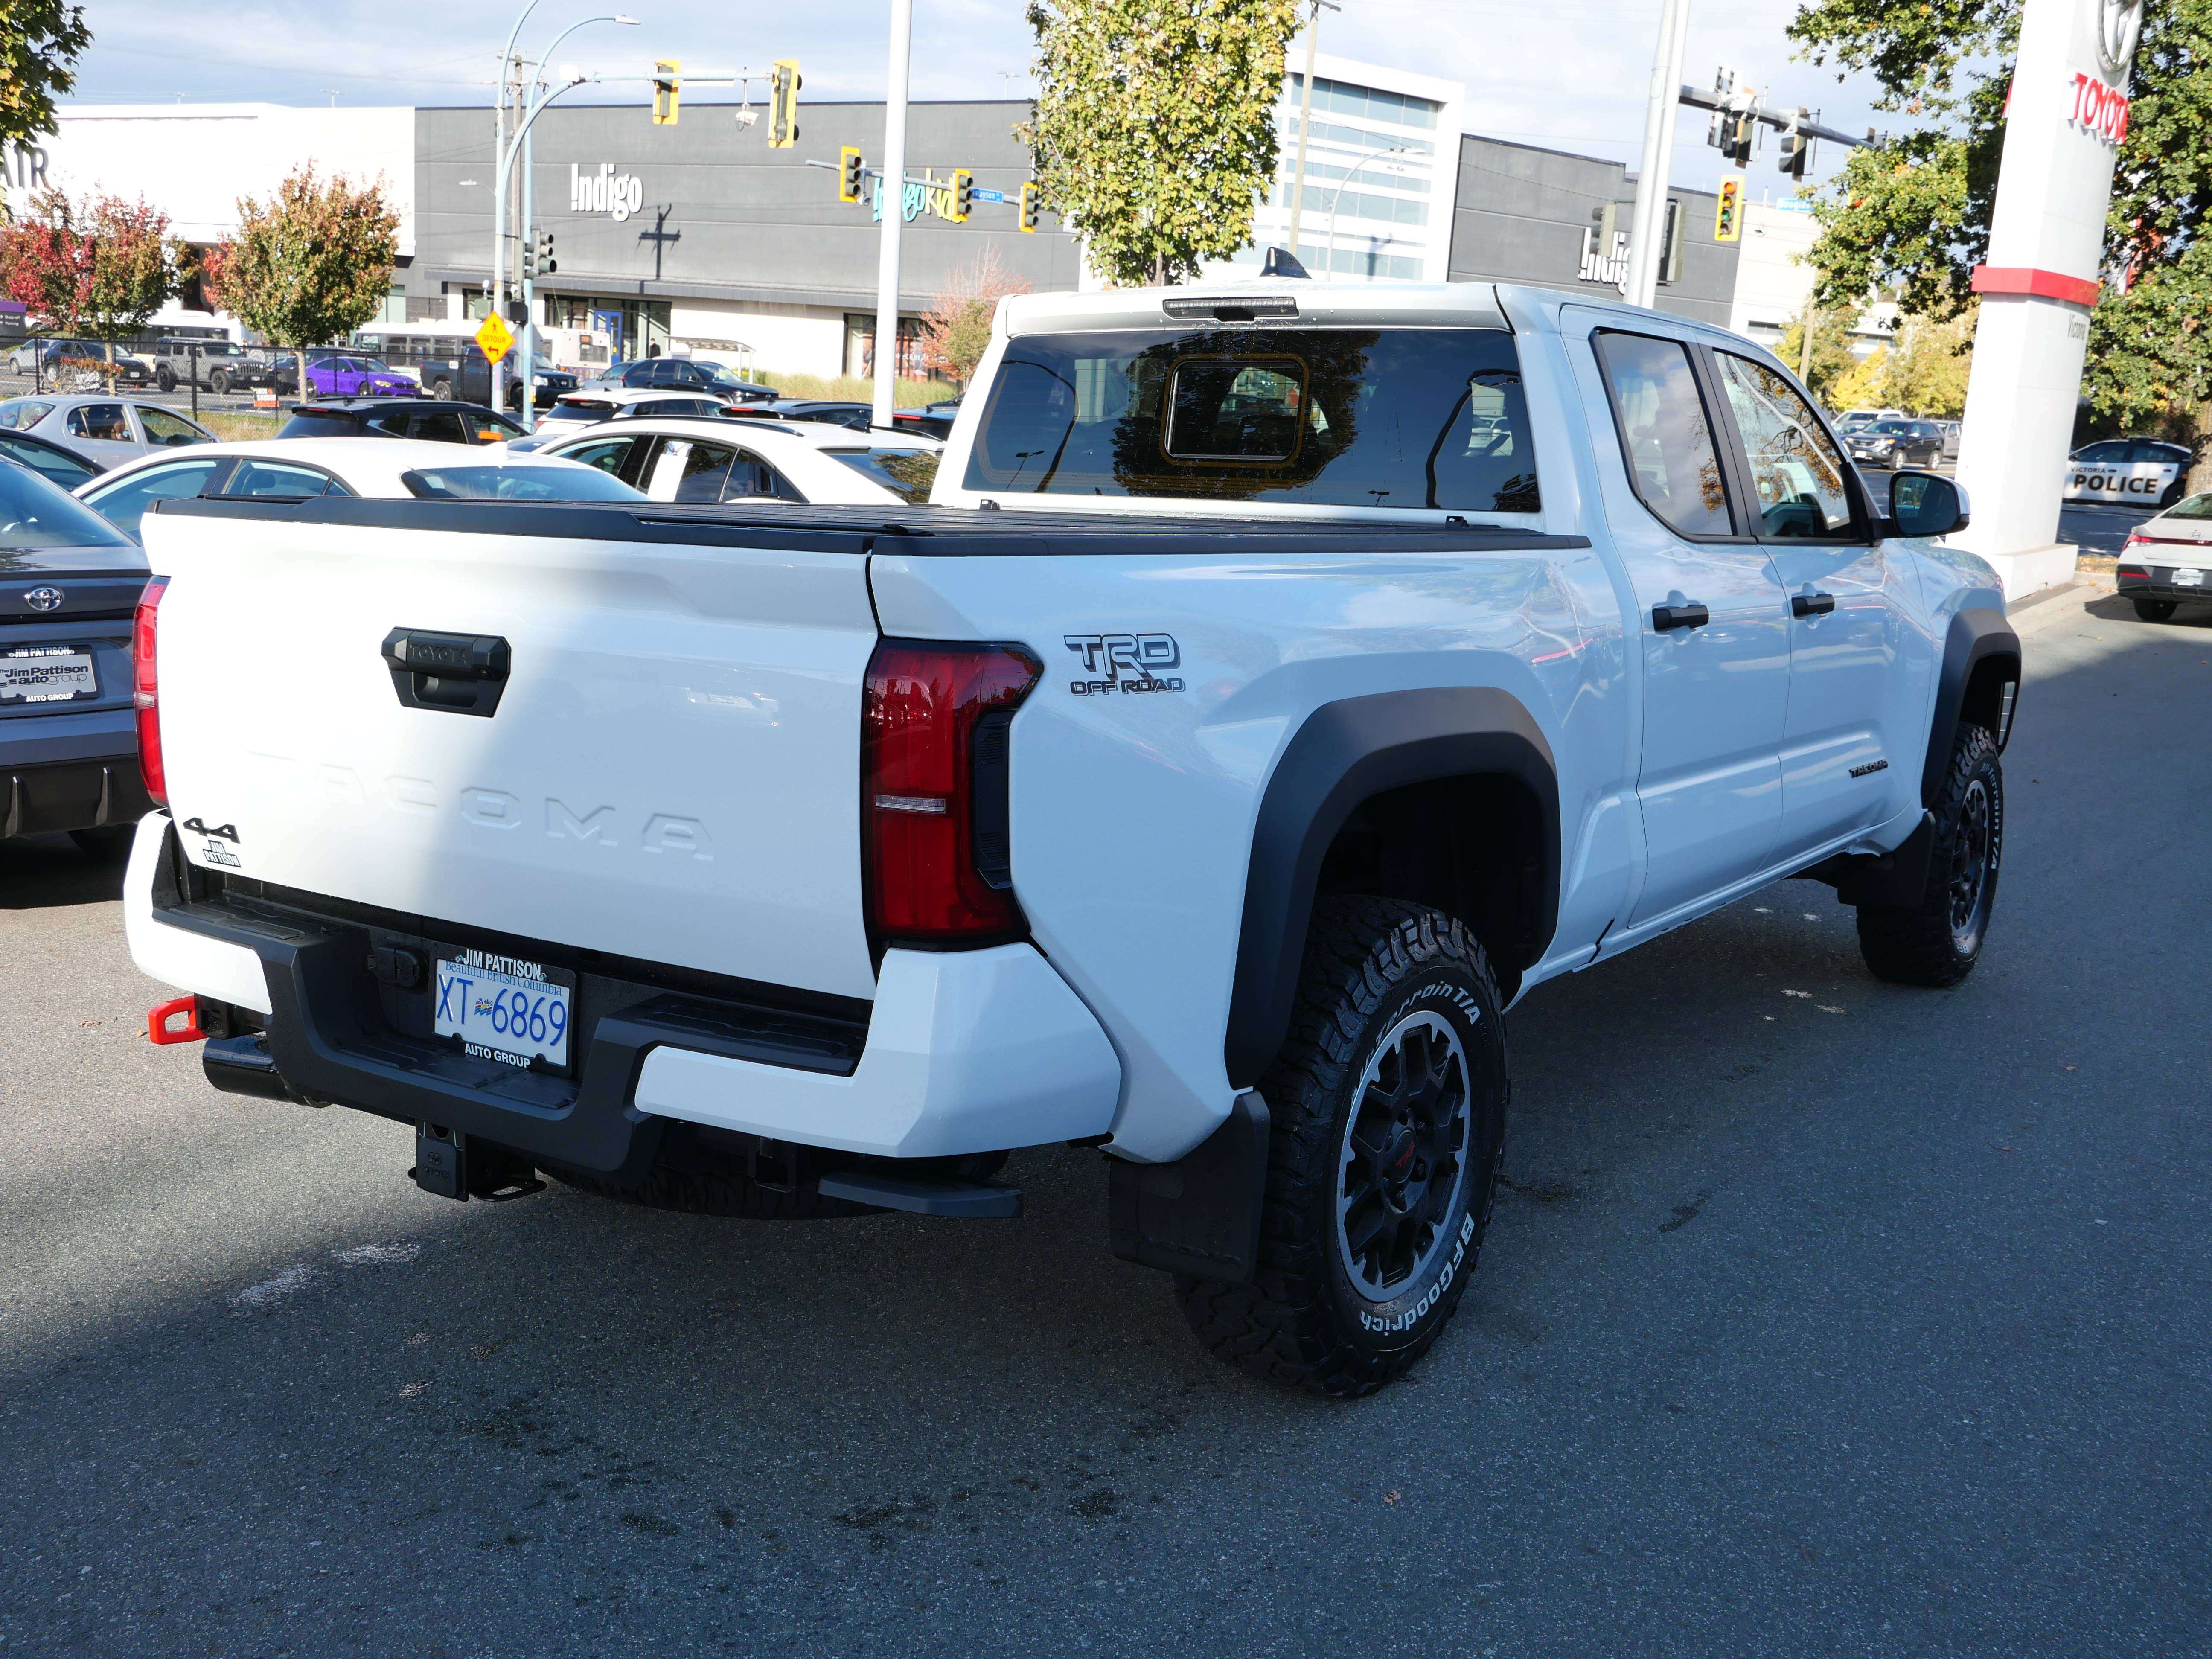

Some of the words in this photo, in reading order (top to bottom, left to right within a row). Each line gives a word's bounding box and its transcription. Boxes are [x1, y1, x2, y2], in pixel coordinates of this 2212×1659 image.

[482, 335, 506, 343] DETOUR
[2073, 474, 2158, 494] POLICE
[15, 648, 29, 658] JIM
[30, 646, 70, 657] PATTISON
[410, 643, 467, 664] TOYOTA
[1064, 633, 1179, 679] TRD
[5, 668, 29, 678] Jim
[31, 665, 89, 676] Pattison
[1070, 681, 1118, 696] OFF
[1121, 678, 1185, 695] ROAD
[47, 693, 74, 701] GROUP
[210, 841, 226, 853] JIM
[204, 850, 241, 867] PATTISON
[463, 949, 483, 968] JIM
[486, 953, 542, 981] PATTISON
[446, 961, 484, 978] Beautiful
[488, 970, 515, 986] British
[518, 977, 562, 997] Columbia
[437, 973, 474, 1025] XT
[492, 989, 567, 1046] 6869
[465, 1043, 492, 1059] AUTO
[494, 1051, 530, 1068] GROUP
